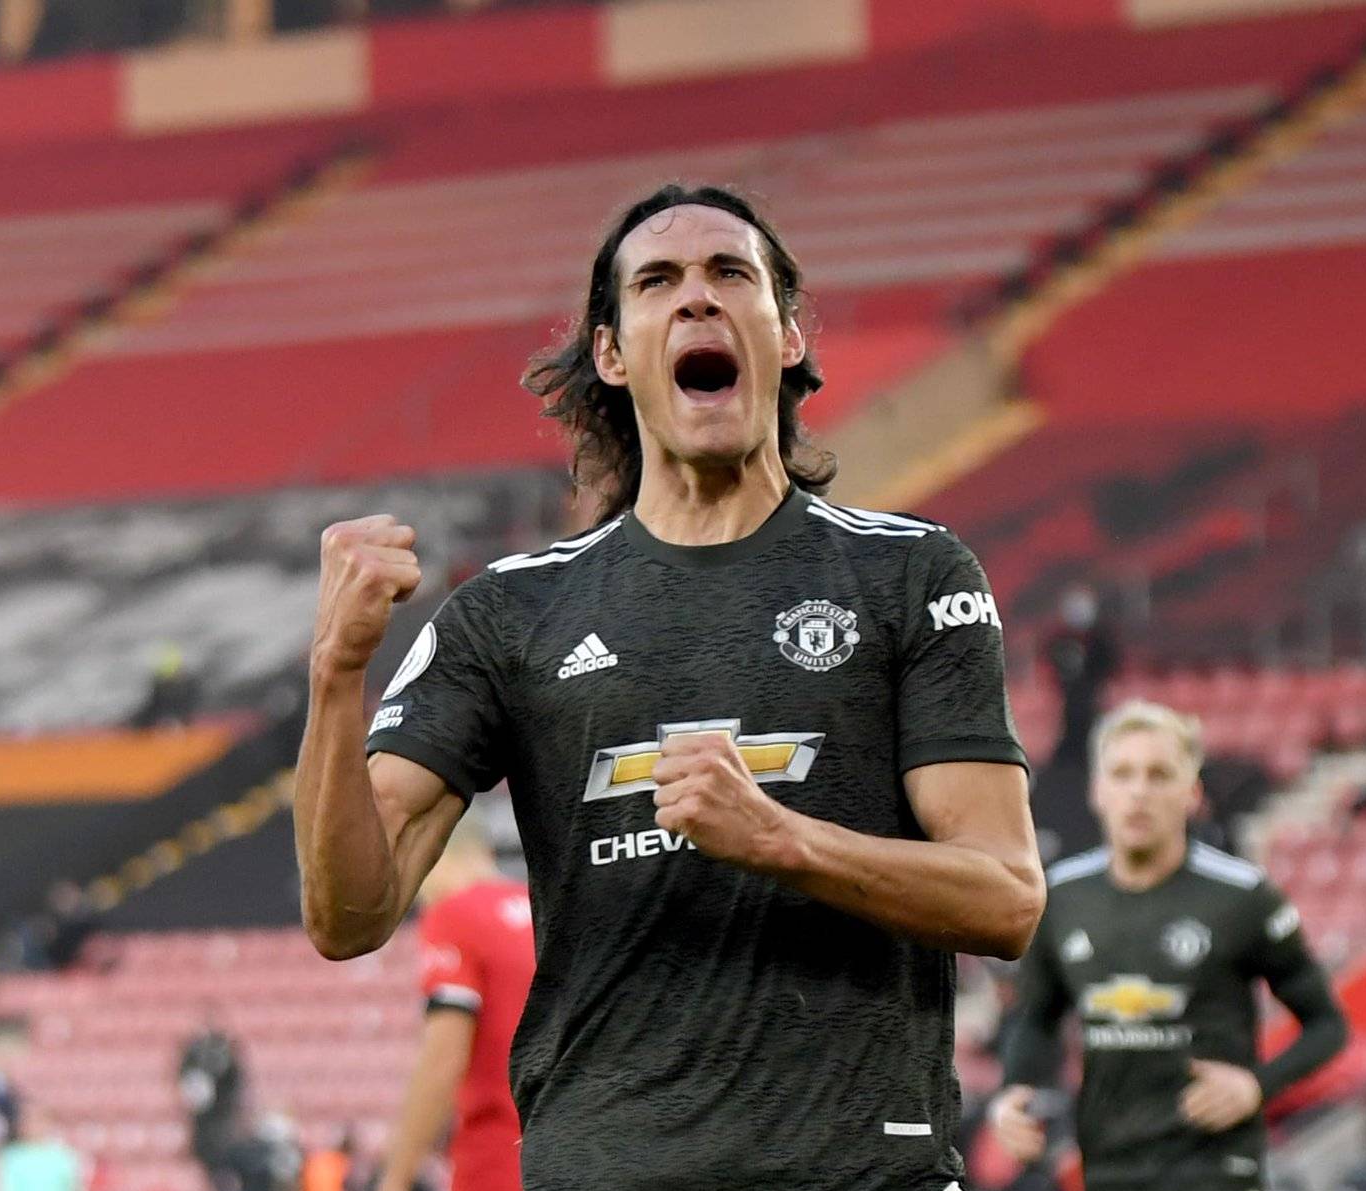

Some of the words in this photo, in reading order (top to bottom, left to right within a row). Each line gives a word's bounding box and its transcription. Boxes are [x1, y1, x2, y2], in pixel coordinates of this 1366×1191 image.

[927, 591, 1003, 631] KOH
[557, 653, 619, 680] adidas
[793, 651, 842, 666] UNITED
[590, 828, 698, 866] CHEV
